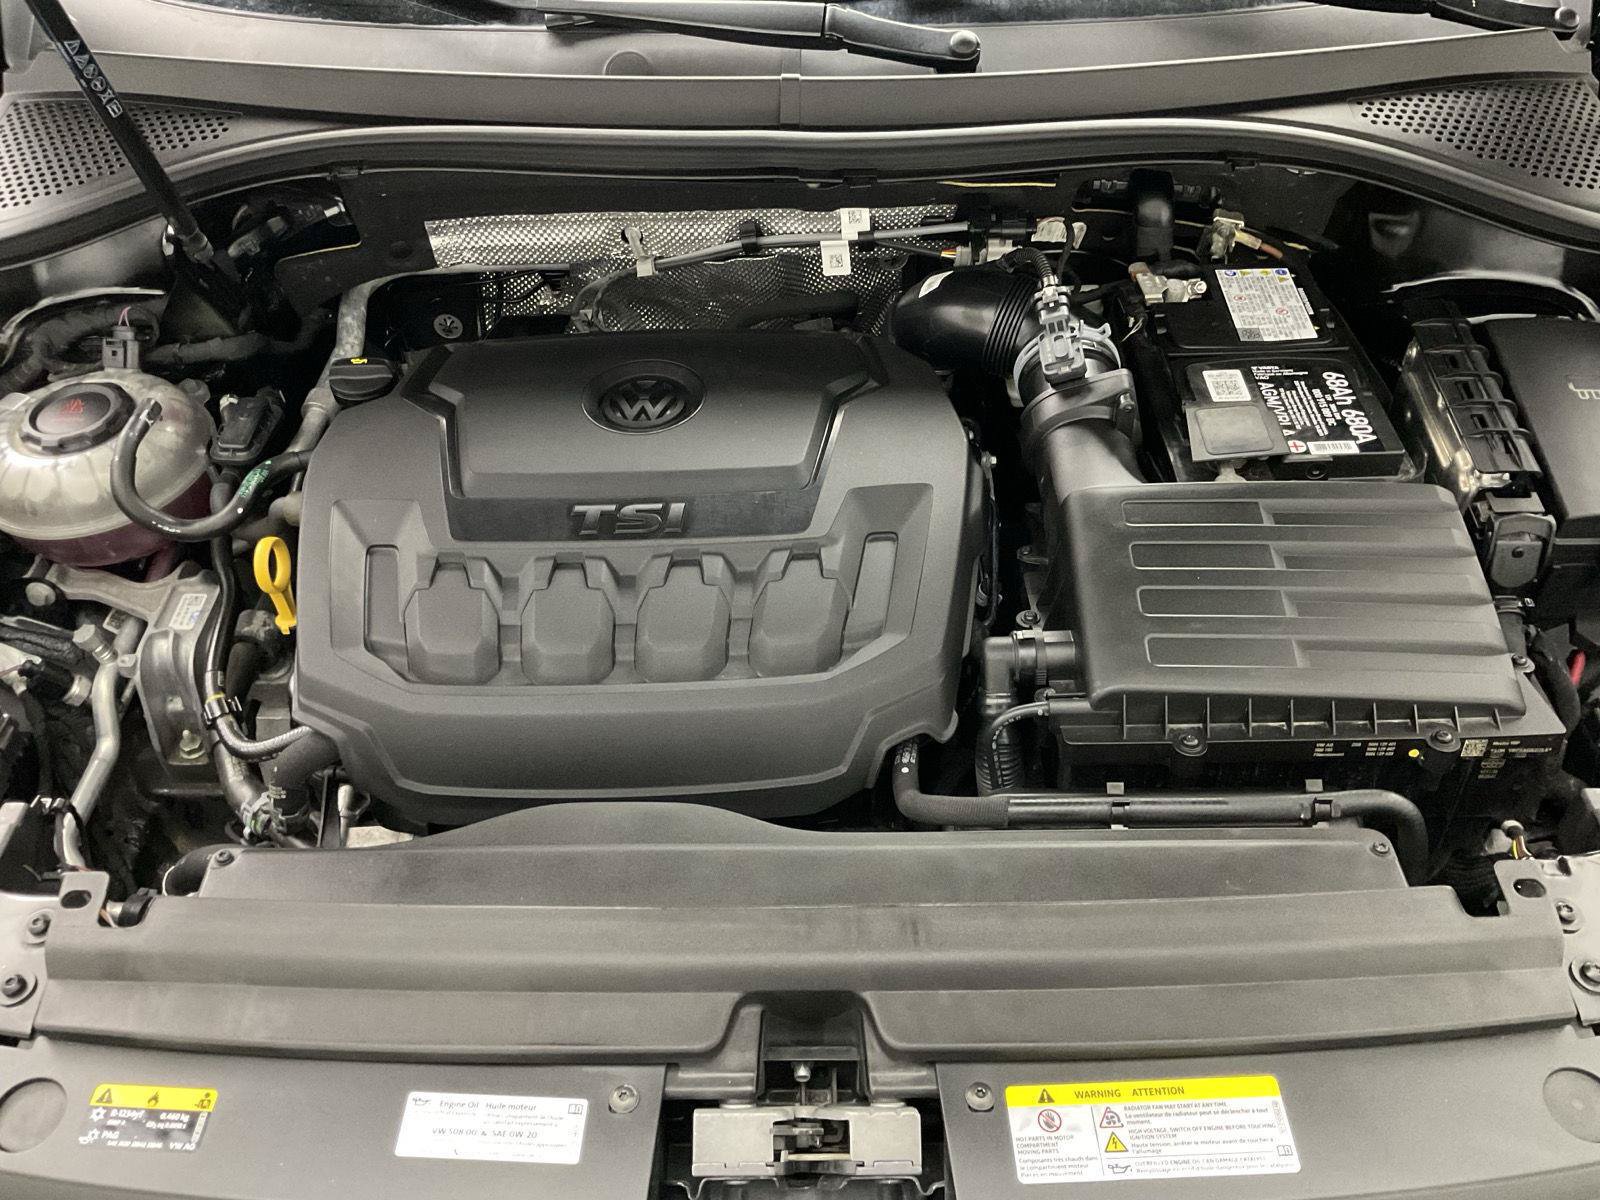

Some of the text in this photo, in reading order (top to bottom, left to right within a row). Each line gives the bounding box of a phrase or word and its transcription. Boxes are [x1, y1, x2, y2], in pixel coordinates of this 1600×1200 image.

[602, 374, 685, 429] VW
[1322, 372, 1377, 444] 68Ah 680A
[571, 502, 686, 535] TSI
[440, 1100, 466, 1109] Engine
[1075, 1086, 1184, 1099] WARNING ATTENTION
